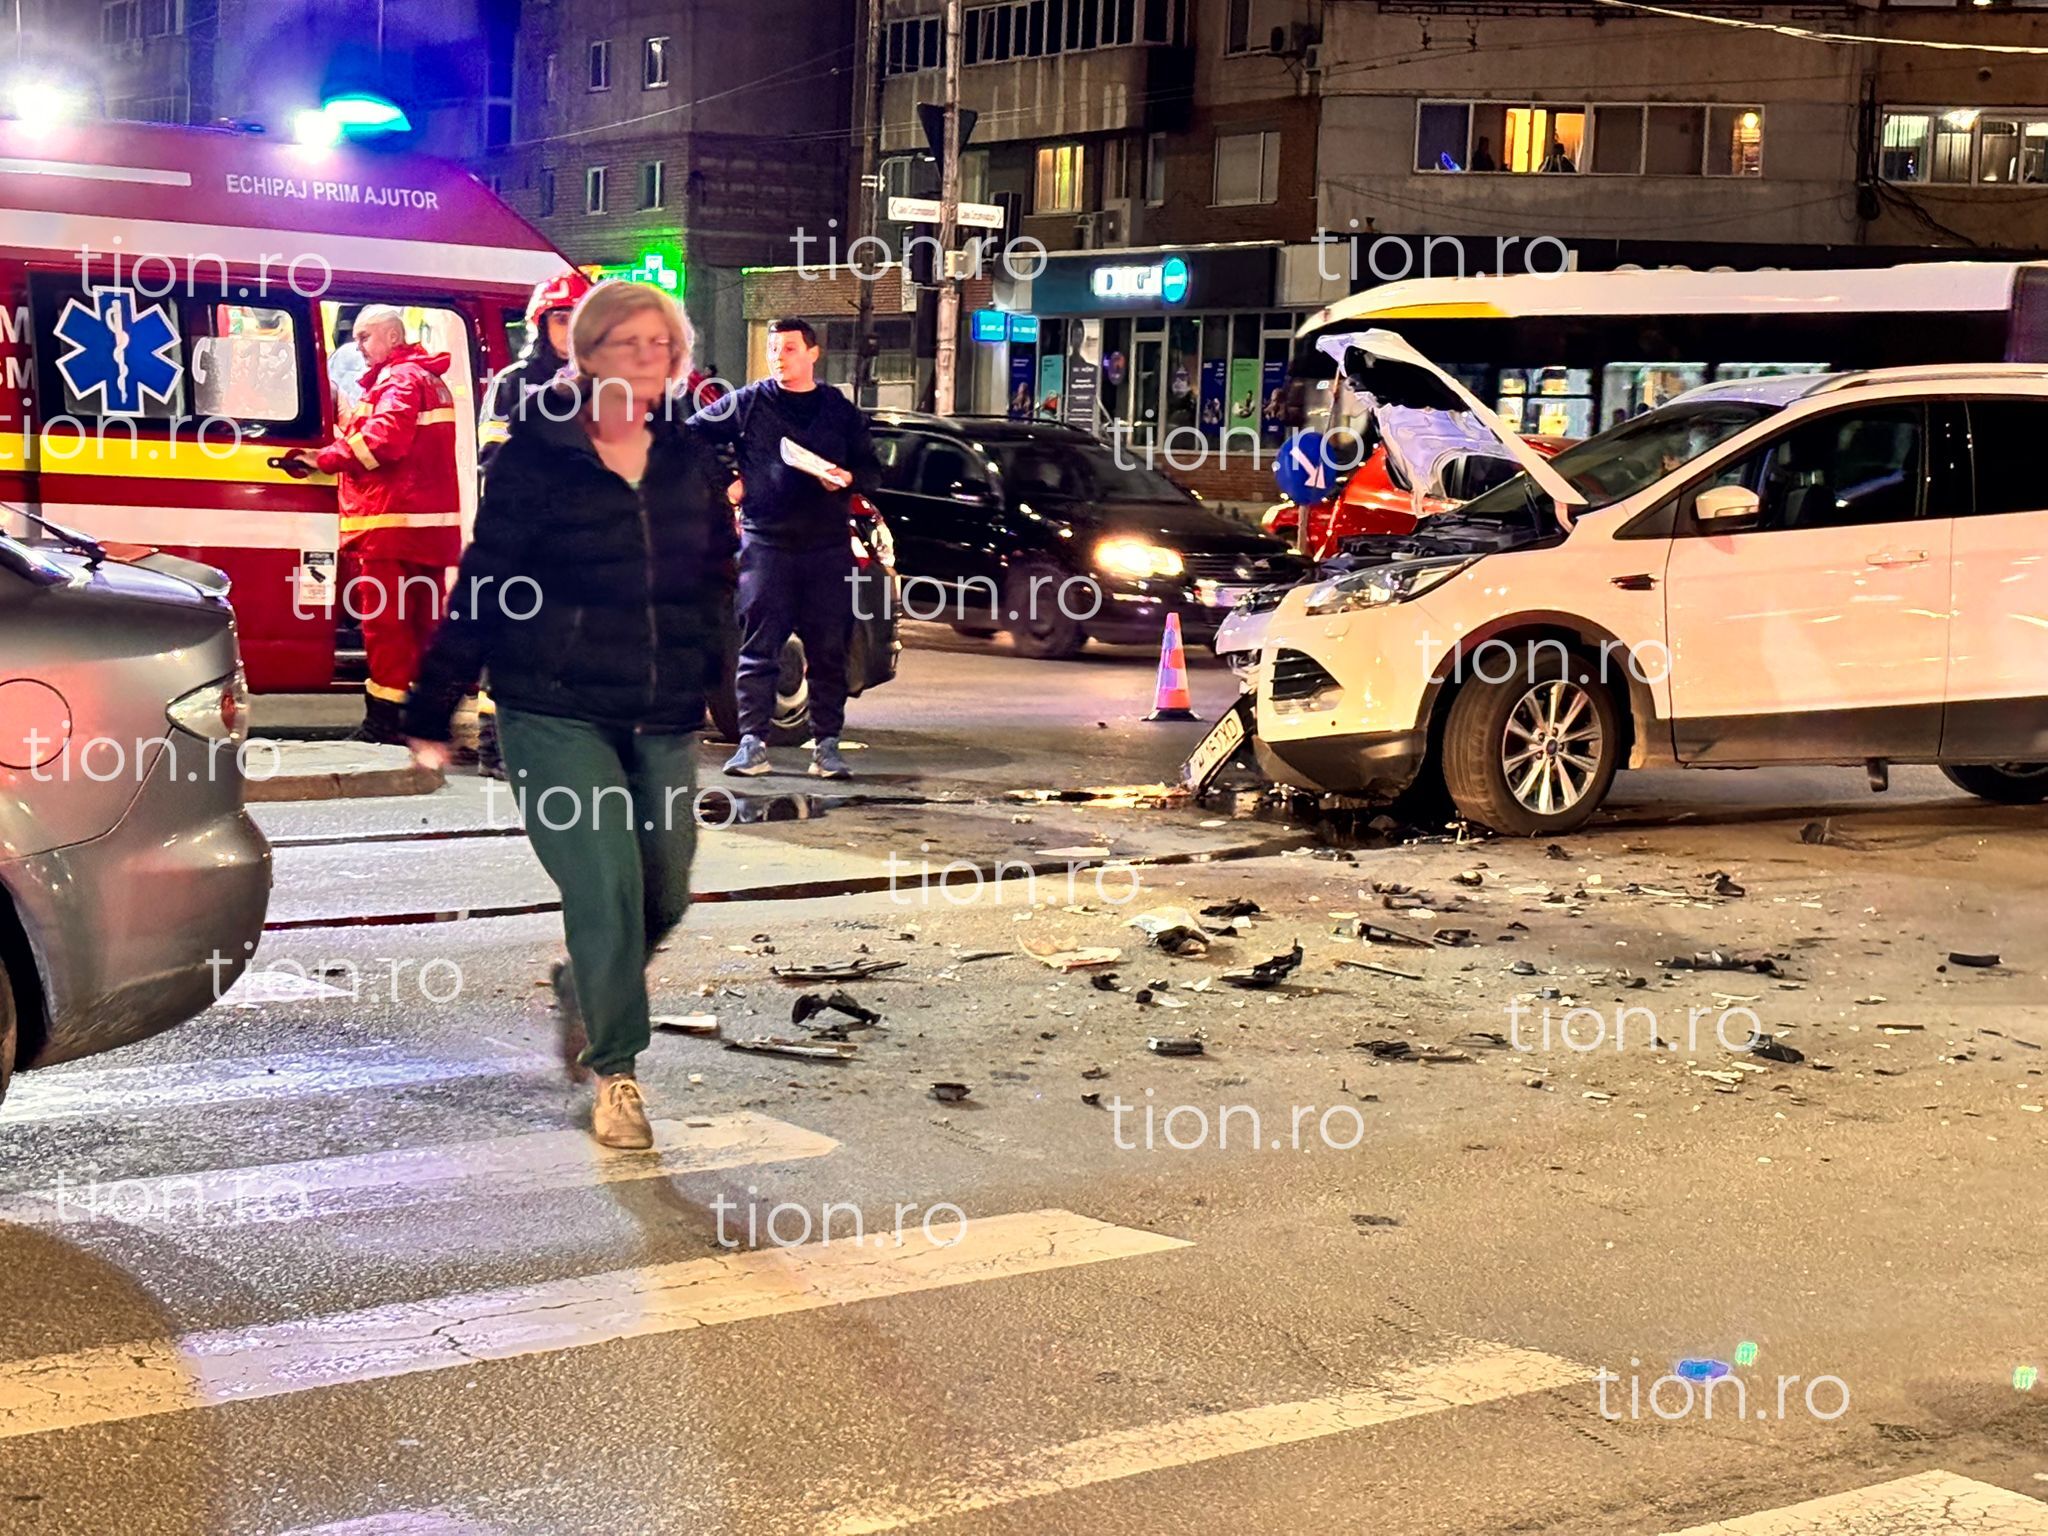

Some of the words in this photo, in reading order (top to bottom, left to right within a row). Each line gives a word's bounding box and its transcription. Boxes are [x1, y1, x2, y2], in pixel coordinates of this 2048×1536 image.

[226, 174, 307, 199] ECHIPAJ
[312, 181, 360, 203] PRIM
[364, 187, 438, 210] AJUTOR
[0, 356, 34, 391] M
